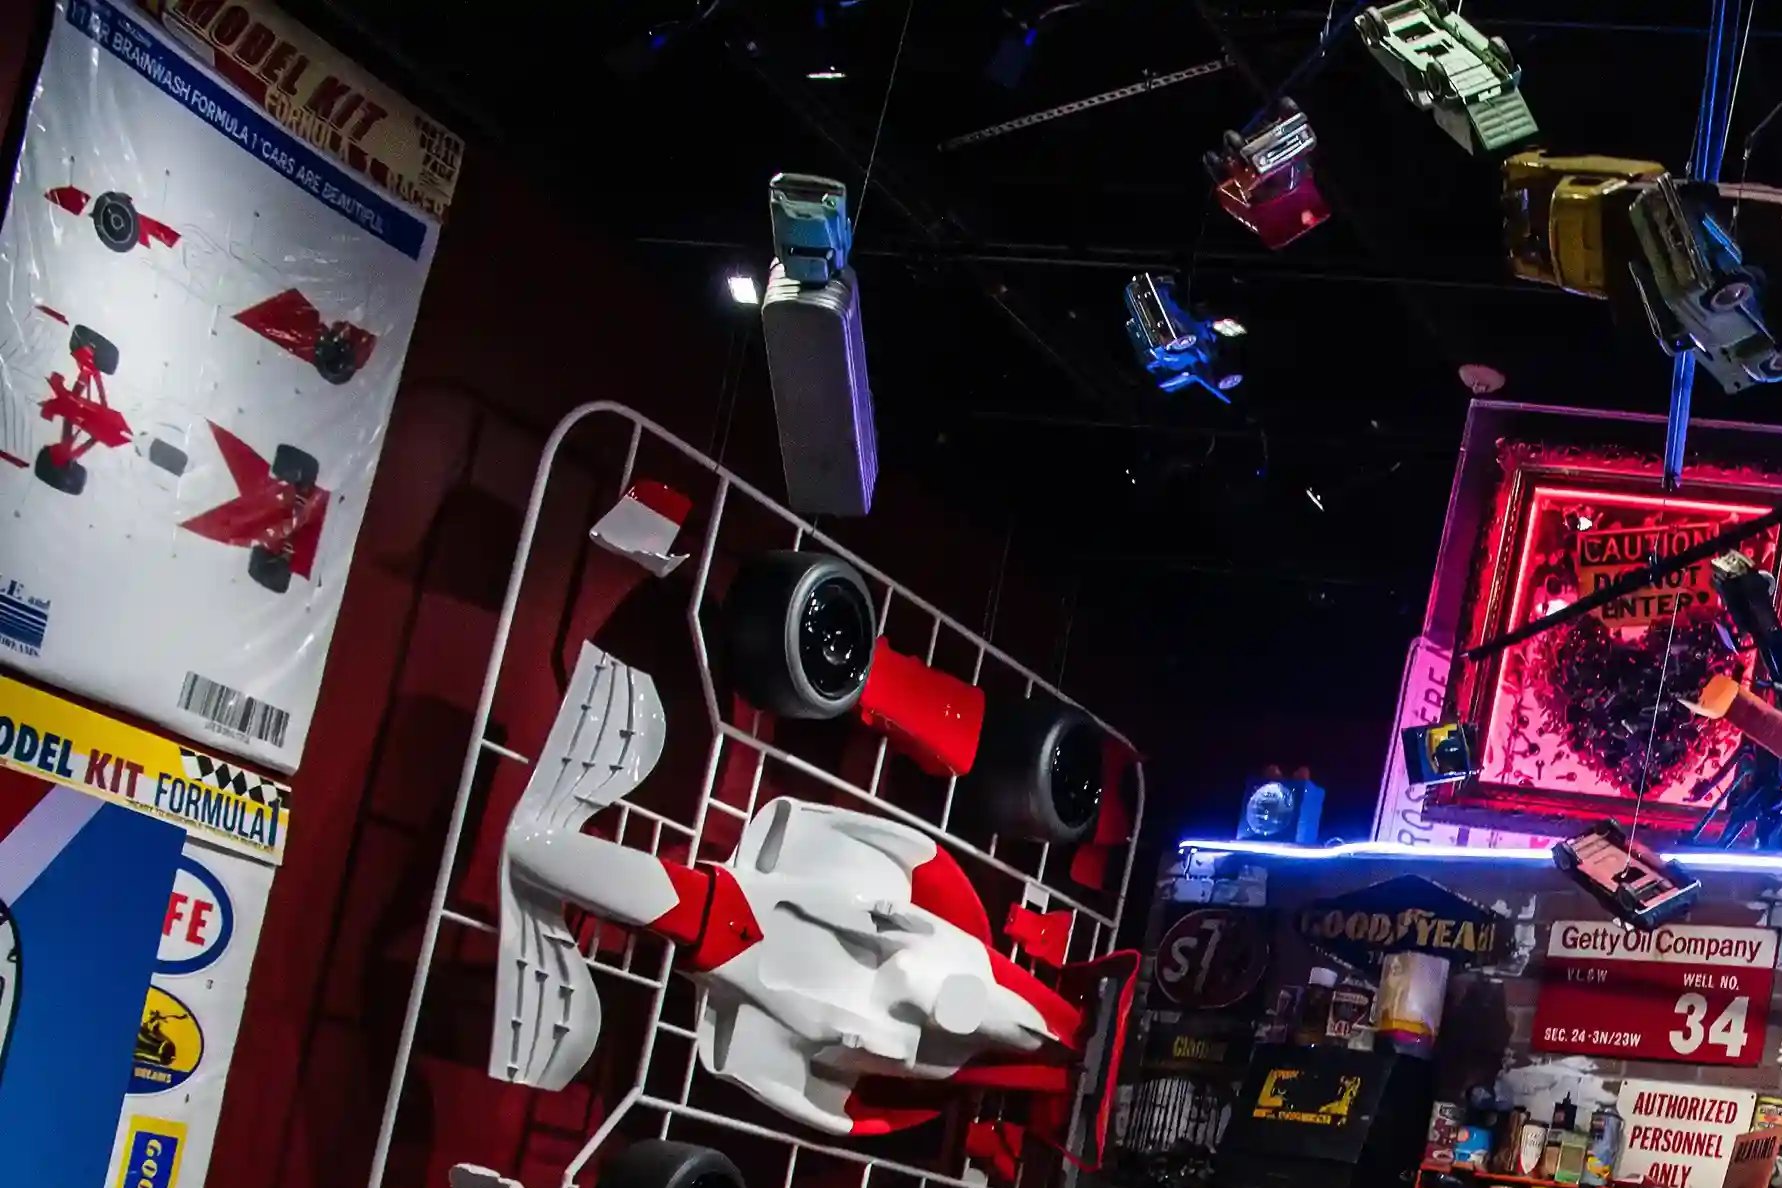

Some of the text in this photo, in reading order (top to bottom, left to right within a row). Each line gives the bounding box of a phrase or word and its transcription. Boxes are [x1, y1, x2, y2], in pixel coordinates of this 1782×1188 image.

[307, 76, 388, 142] KIT
[191, 89, 249, 145] FORMULA
[296, 166, 322, 195] ARE
[322, 180, 386, 236] BEAUTIFUL
[84, 748, 145, 799] KIT
[155, 771, 265, 844] FORMULA
[161, 891, 214, 947] FE
[1562, 926, 1762, 963] Getty Oil Company
[1683, 973, 1740, 991] WELL NO.
[1544, 1027, 1568, 1043] SEC.
[1669, 992, 1750, 1058] 34
[1632, 1091, 1738, 1125] AUTHORIZED
[1629, 1126, 1724, 1159] PERSONNEL
